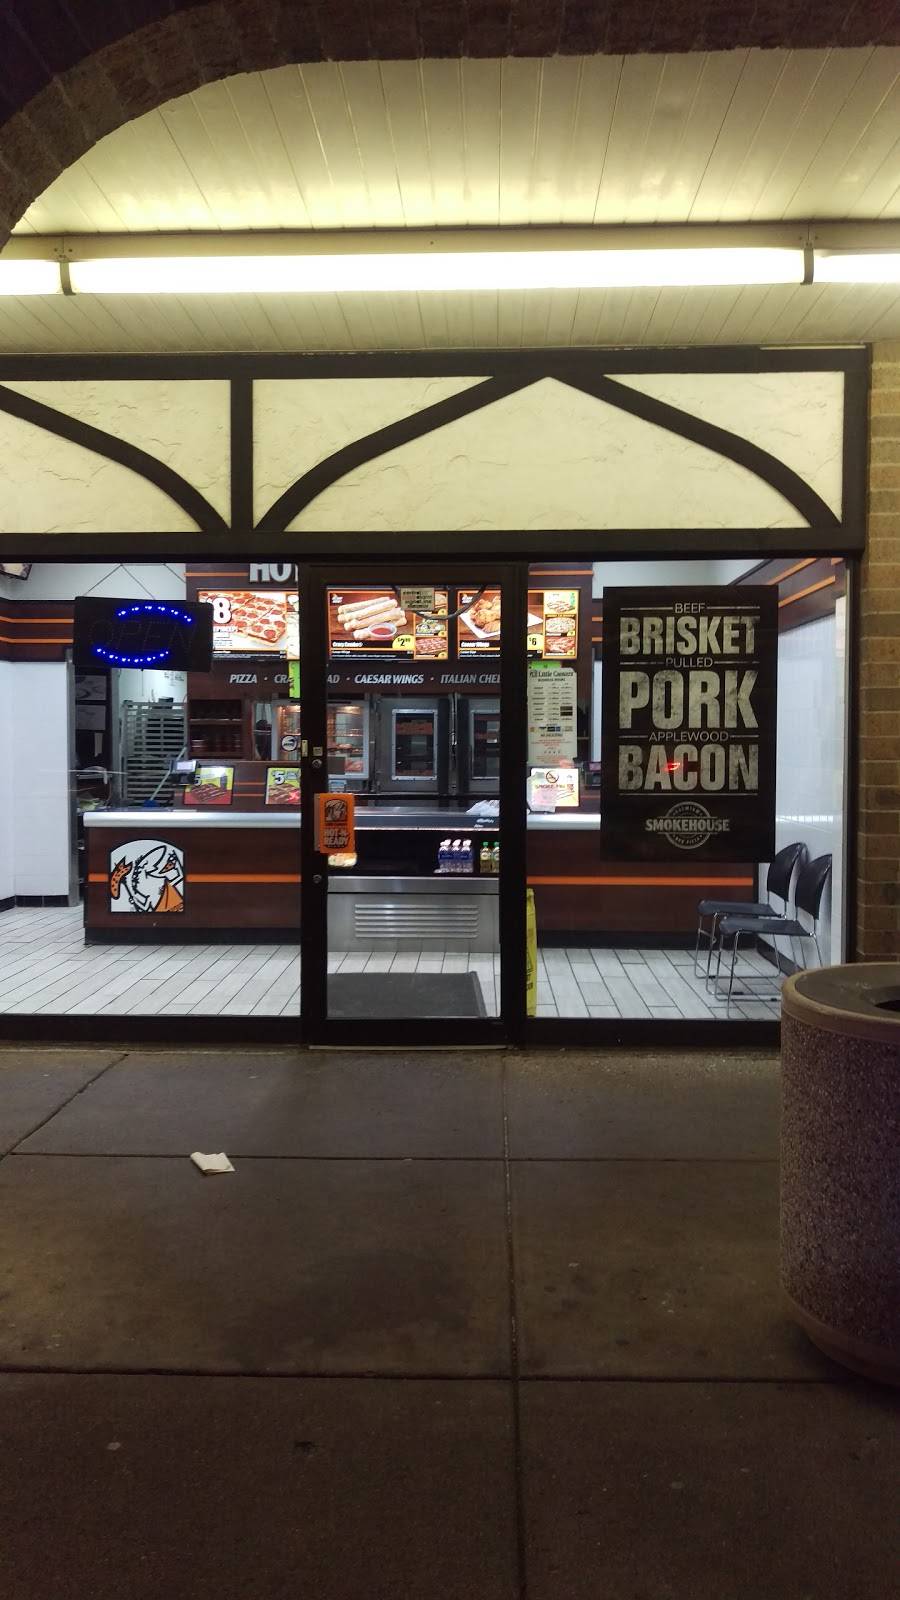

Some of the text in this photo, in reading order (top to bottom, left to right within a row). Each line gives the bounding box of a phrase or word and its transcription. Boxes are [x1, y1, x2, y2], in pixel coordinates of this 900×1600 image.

[674, 603, 706, 614] BEEF
[89, 619, 197, 652] OPEN
[619, 616, 760, 655] BRISKET
[666, 657, 713, 668] PULLED
[229, 674, 258, 684] PIZZA
[354, 674, 392, 684] CAESAR
[393, 674, 424, 684] WINGS
[440, 674, 477, 684] ITALIAN
[618, 670, 759, 730] PORK
[648, 731, 729, 743] APPLEWOOD
[618, 744, 759, 791] BACON
[644, 818, 731, 832] SMOKEHOUSE
[323, 836, 349, 846] READY
